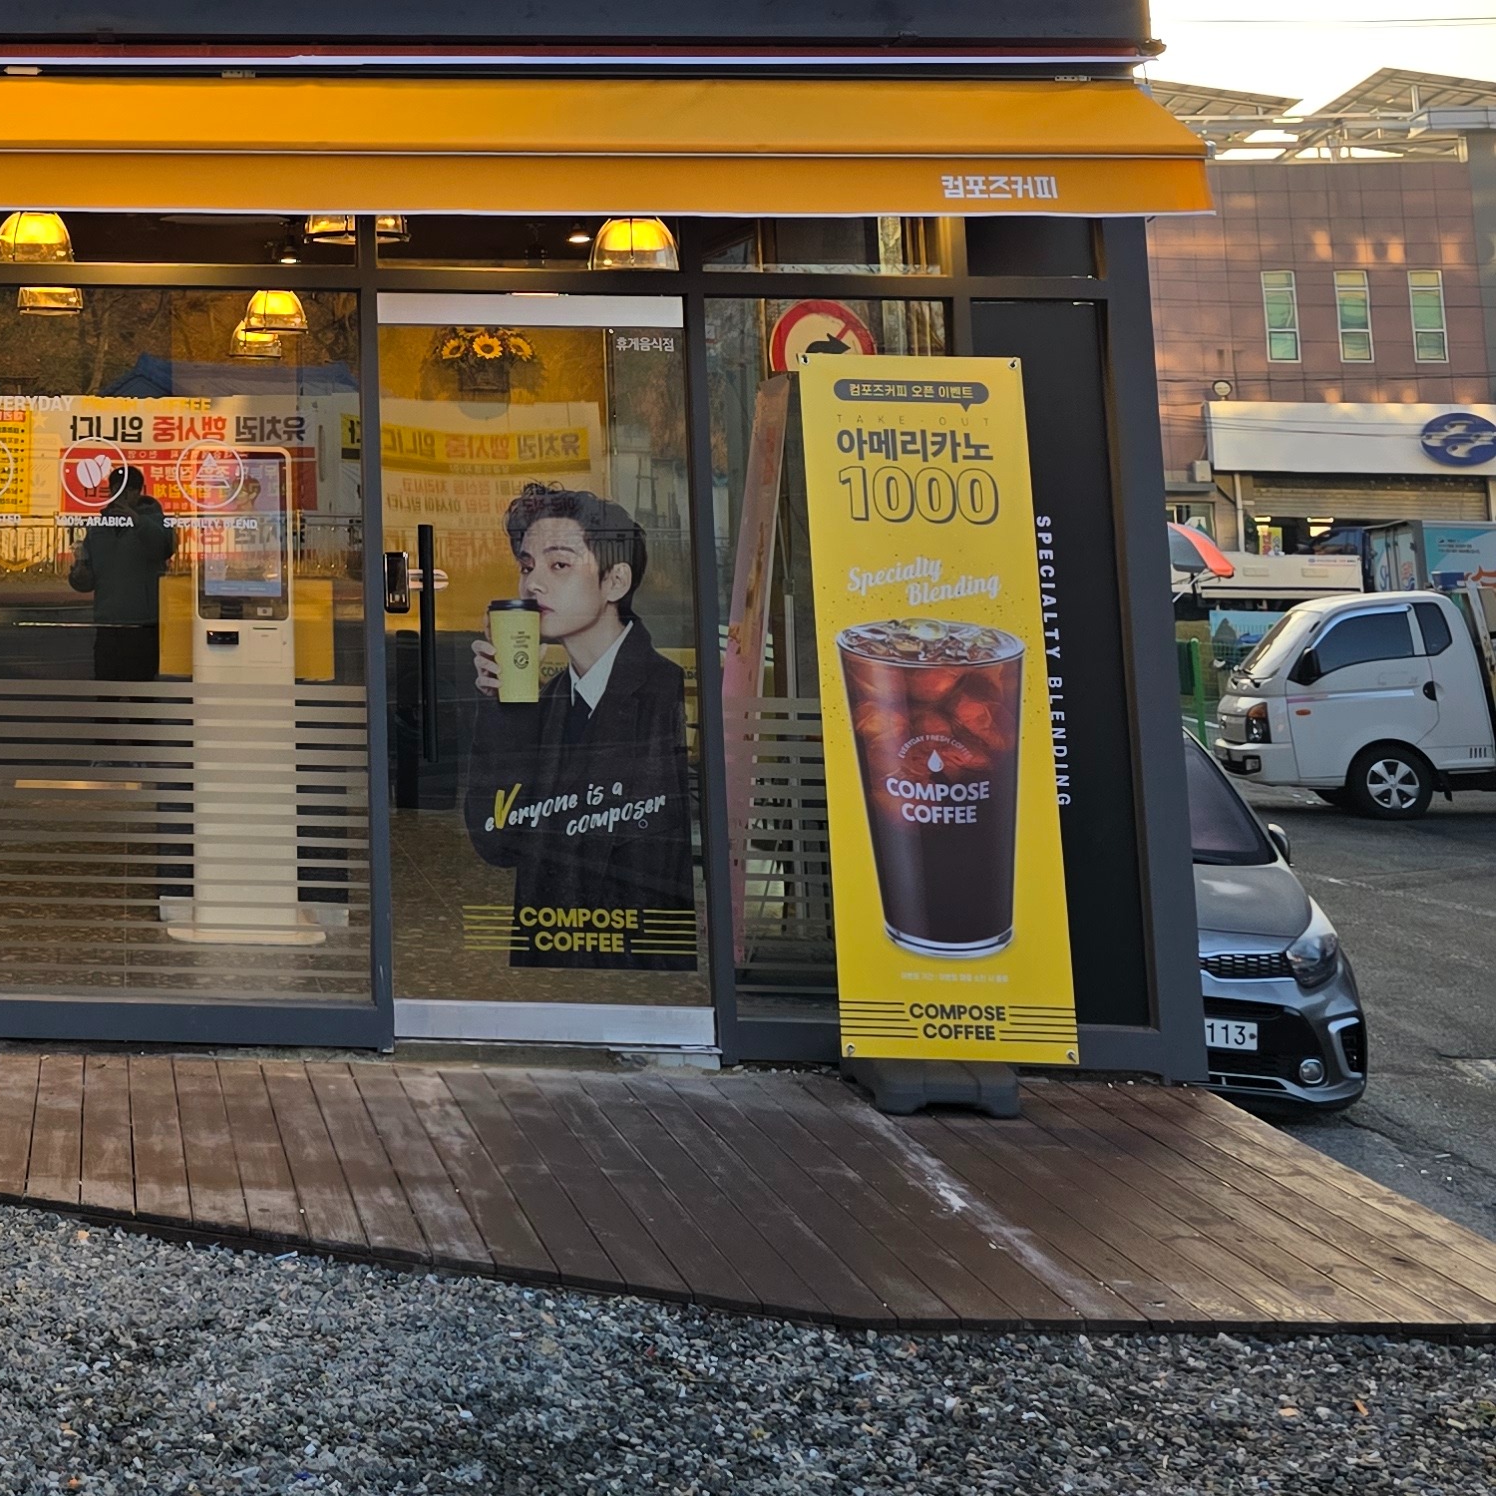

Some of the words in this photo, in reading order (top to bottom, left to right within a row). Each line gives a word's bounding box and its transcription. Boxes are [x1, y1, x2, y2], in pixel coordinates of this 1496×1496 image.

[941, 175, 1059, 199] 컴포즈커피
[616, 337, 675, 352] 휴게음식점
[849, 383, 907, 397] 컴포즈커피
[911, 385, 935, 398] 오픈
[938, 386, 974, 399] 이벤트
[837, 428, 994, 463] 아메리카노
[839, 466, 999, 525] 1000
[86, 516, 134, 528] ARABICA
[222, 518, 259, 530] BLEND
[847, 556, 943, 597] Specialty
[1036, 515, 1061, 659] SPECIALTY
[907, 573, 1001, 606] Blending
[898, 735, 924, 759] EVERYDAY
[926, 735, 950, 743] FRESH
[1047, 676, 1071, 806] BLENDING
[587, 784, 604, 805] is
[612, 782, 623, 796] a
[886, 777, 991, 802] COMPOSE
[566, 795, 666, 836] composer
[901, 803, 977, 824] COFFEE
[519, 907, 639, 929] COMPOSE
[535, 931, 624, 952] COFFEE
[909, 1003, 1006, 1022] COMPOSE
[922, 1023, 995, 1041] COFFEE
[1206, 1023, 1246, 1046] 113
